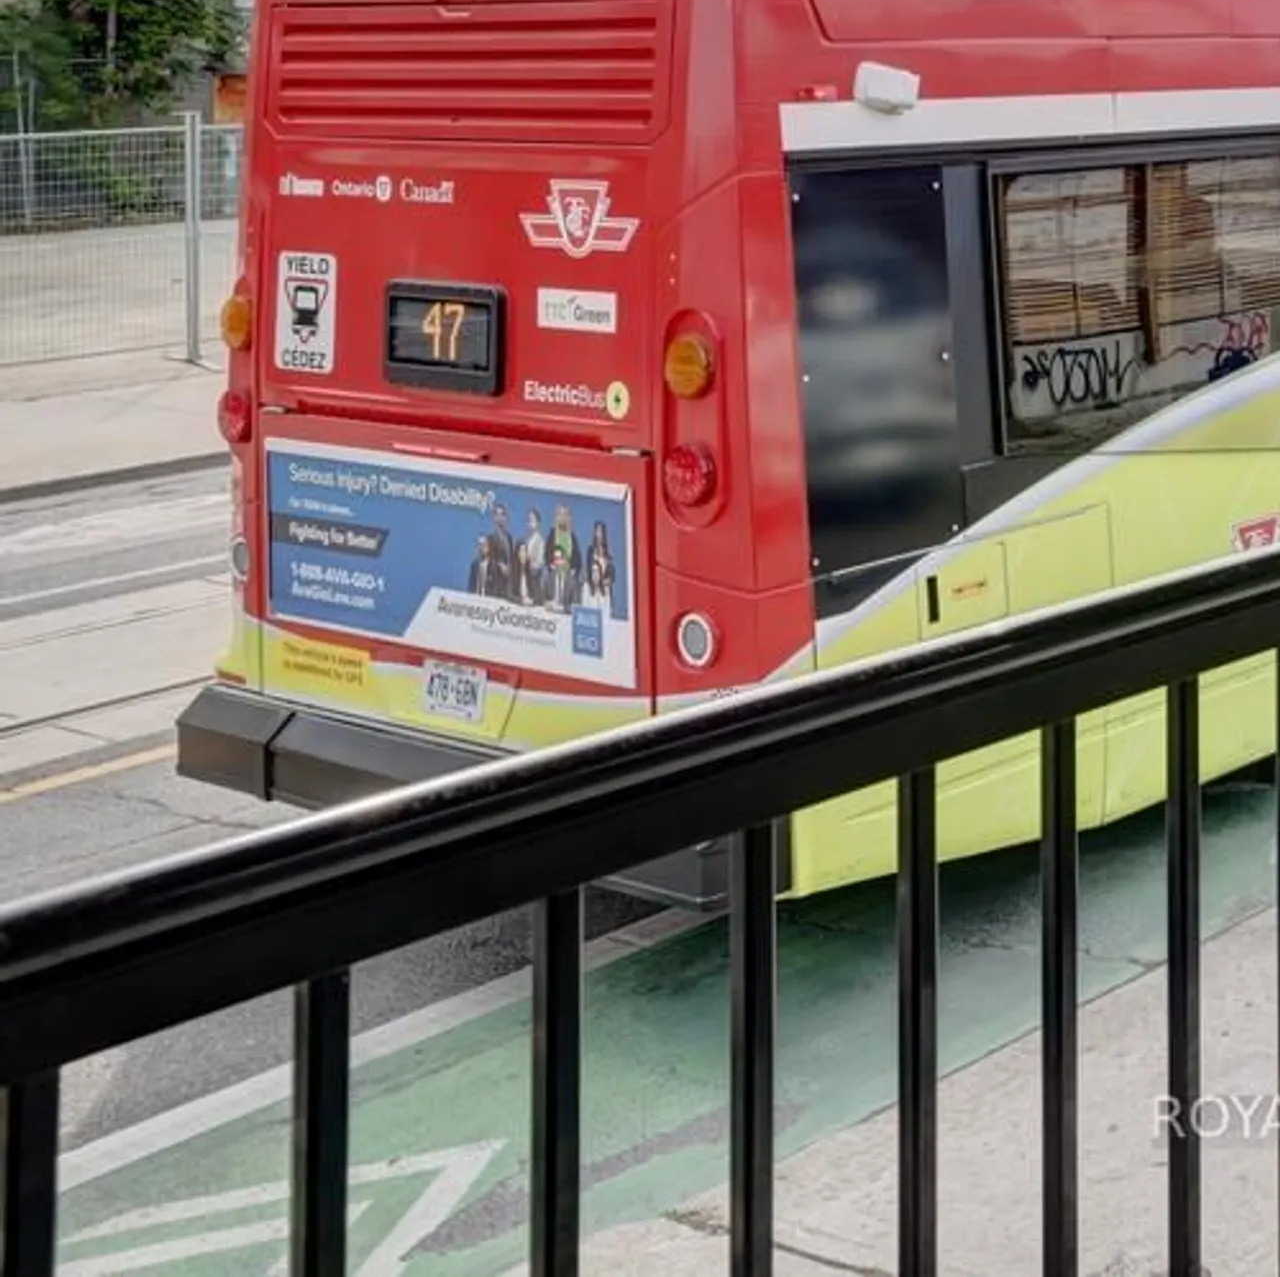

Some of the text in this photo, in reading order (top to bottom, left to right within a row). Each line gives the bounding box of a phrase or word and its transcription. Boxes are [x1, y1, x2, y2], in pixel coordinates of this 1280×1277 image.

[286, 255, 329, 275] YIELD
[422, 302, 466, 361] 47
[282, 345, 327, 369] CÉDEZ
[288, 463, 335, 486] Serious
[379, 476, 427, 500] Denied
